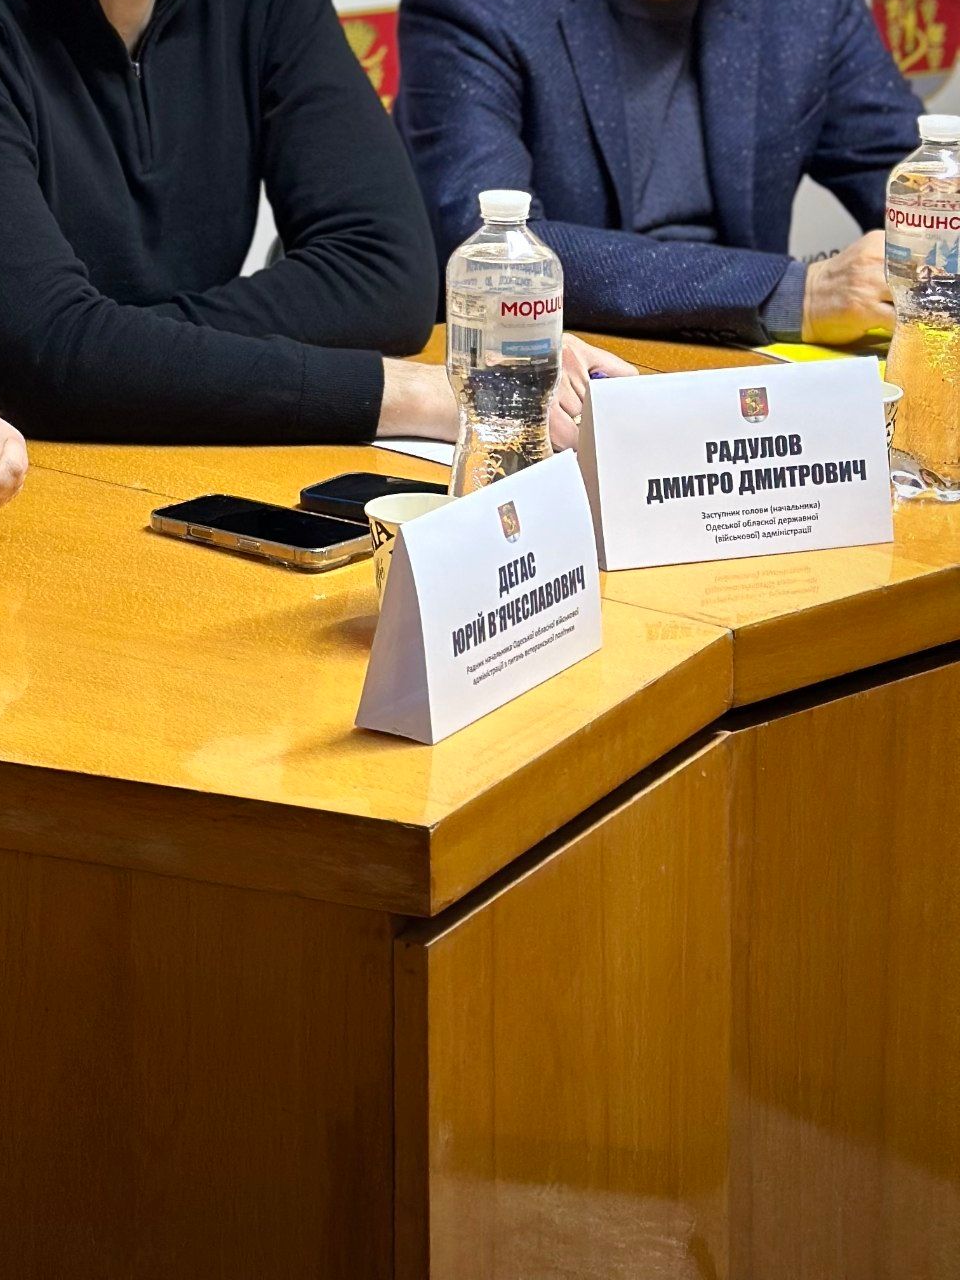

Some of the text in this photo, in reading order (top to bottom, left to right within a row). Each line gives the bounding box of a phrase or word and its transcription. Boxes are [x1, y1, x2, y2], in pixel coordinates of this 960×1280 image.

[706, 434, 803, 464] РАДУЛОВ
[646, 459, 867, 504] ДМИТРО ДМИТРОВИЧ
[701, 501, 821, 520] Заступник голови (начальника)
[705, 521, 741, 532] Одеської
[778, 513, 819, 525] державної
[715, 526, 812, 543] (військової) адміністрації
[498, 552, 536, 598] ДЕГАС
[452, 611, 486, 657] ЮРІЙ
